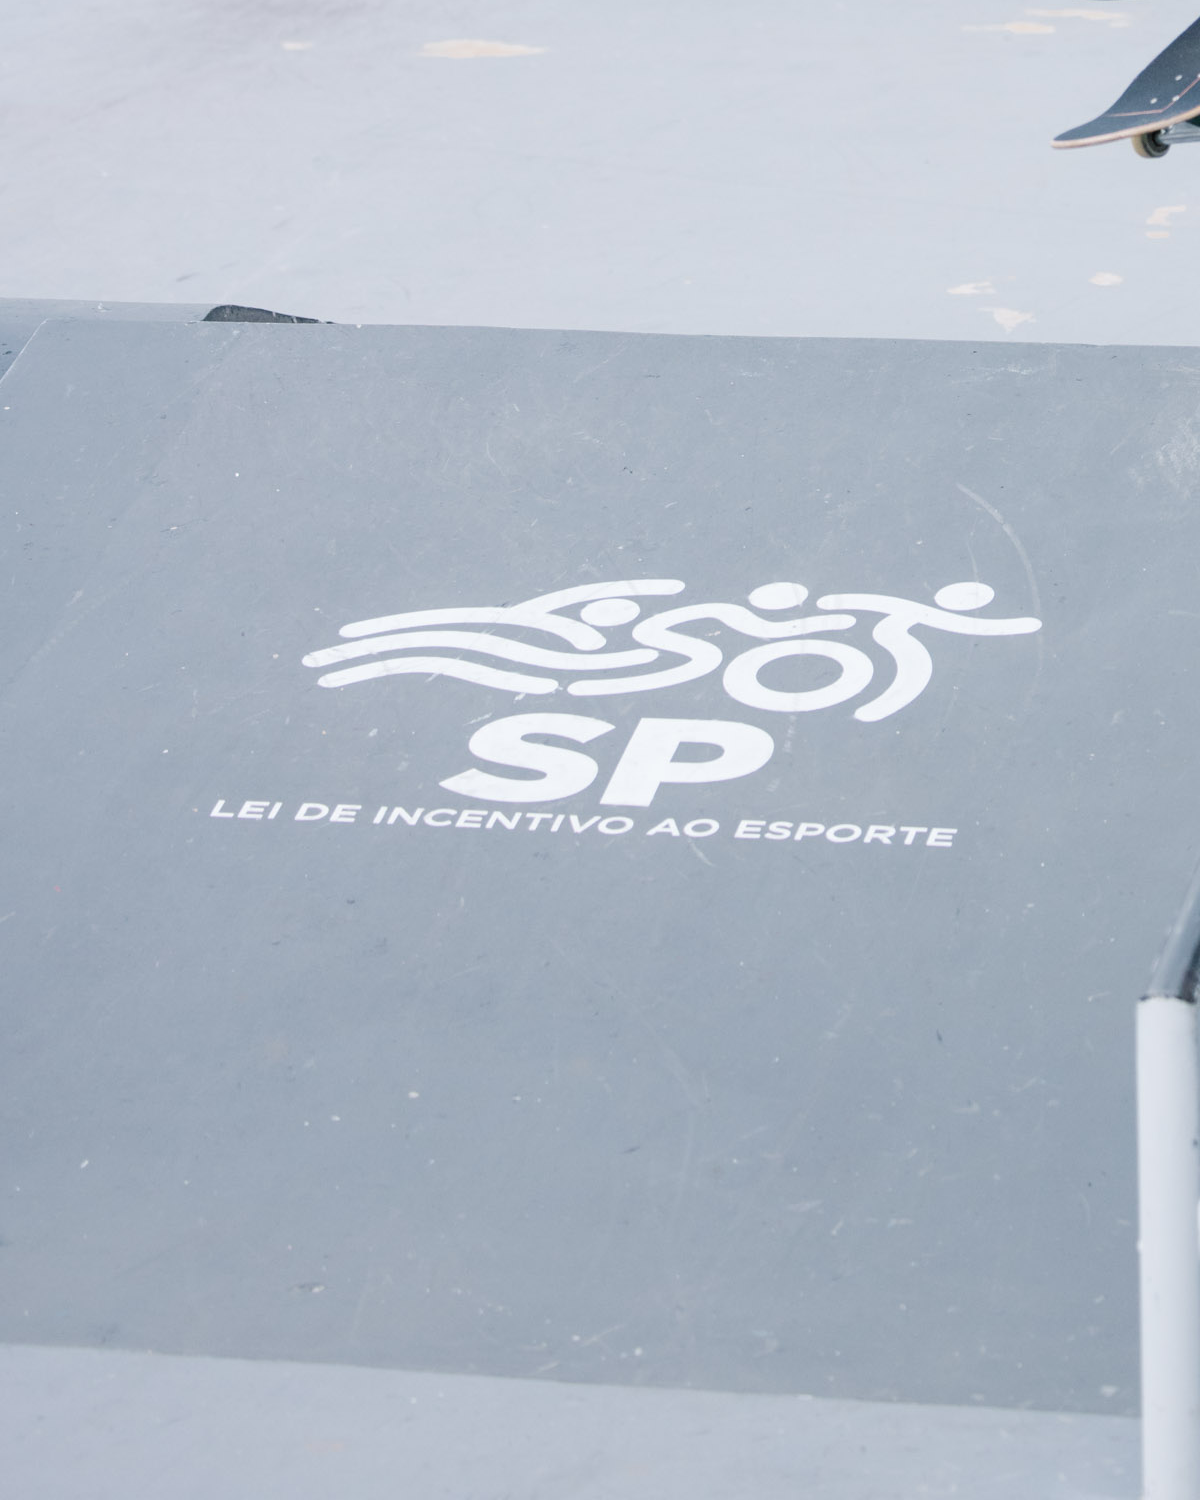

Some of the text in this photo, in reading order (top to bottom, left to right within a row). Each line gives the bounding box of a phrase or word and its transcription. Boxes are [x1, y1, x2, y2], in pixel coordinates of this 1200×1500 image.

[438, 713, 775, 807] SP
[208, 798, 961, 849] LEI DE INCENTIVO AO ESPORTE
